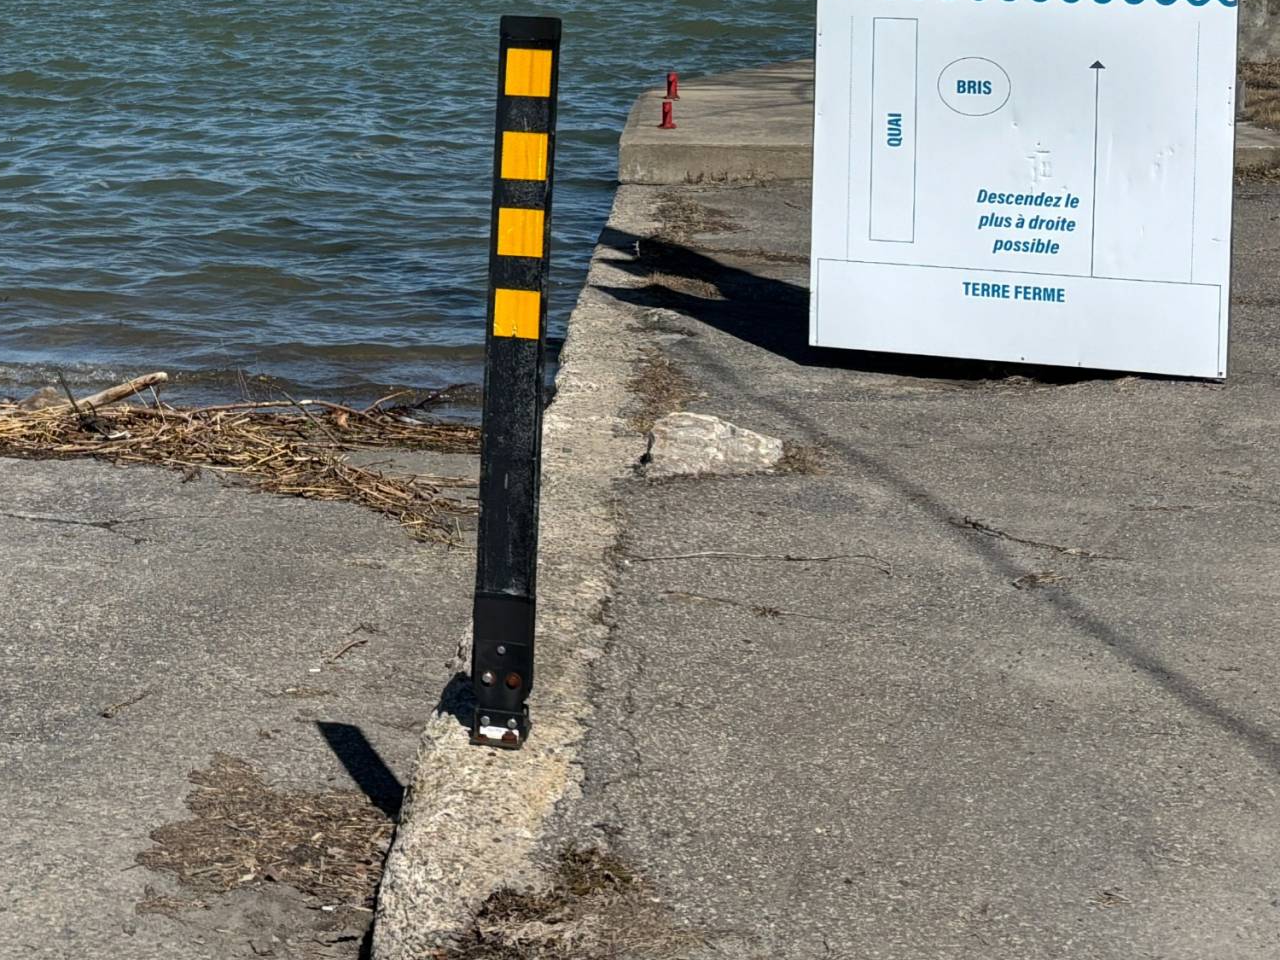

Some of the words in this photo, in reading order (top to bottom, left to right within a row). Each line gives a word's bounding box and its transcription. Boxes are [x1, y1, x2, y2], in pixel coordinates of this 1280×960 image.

[956, 79, 992, 95] BRIS
[887, 112, 902, 148] QUAI
[976, 188, 1063, 208] Descendez
[1064, 193, 1080, 209] le
[977, 213, 1013, 230] plus
[1015, 213, 1026, 230] à
[1028, 215, 1077, 232] droite
[992, 238, 1060, 255] possible
[962, 281, 1010, 299] TERRE
[1014, 285, 1065, 303] FERME
